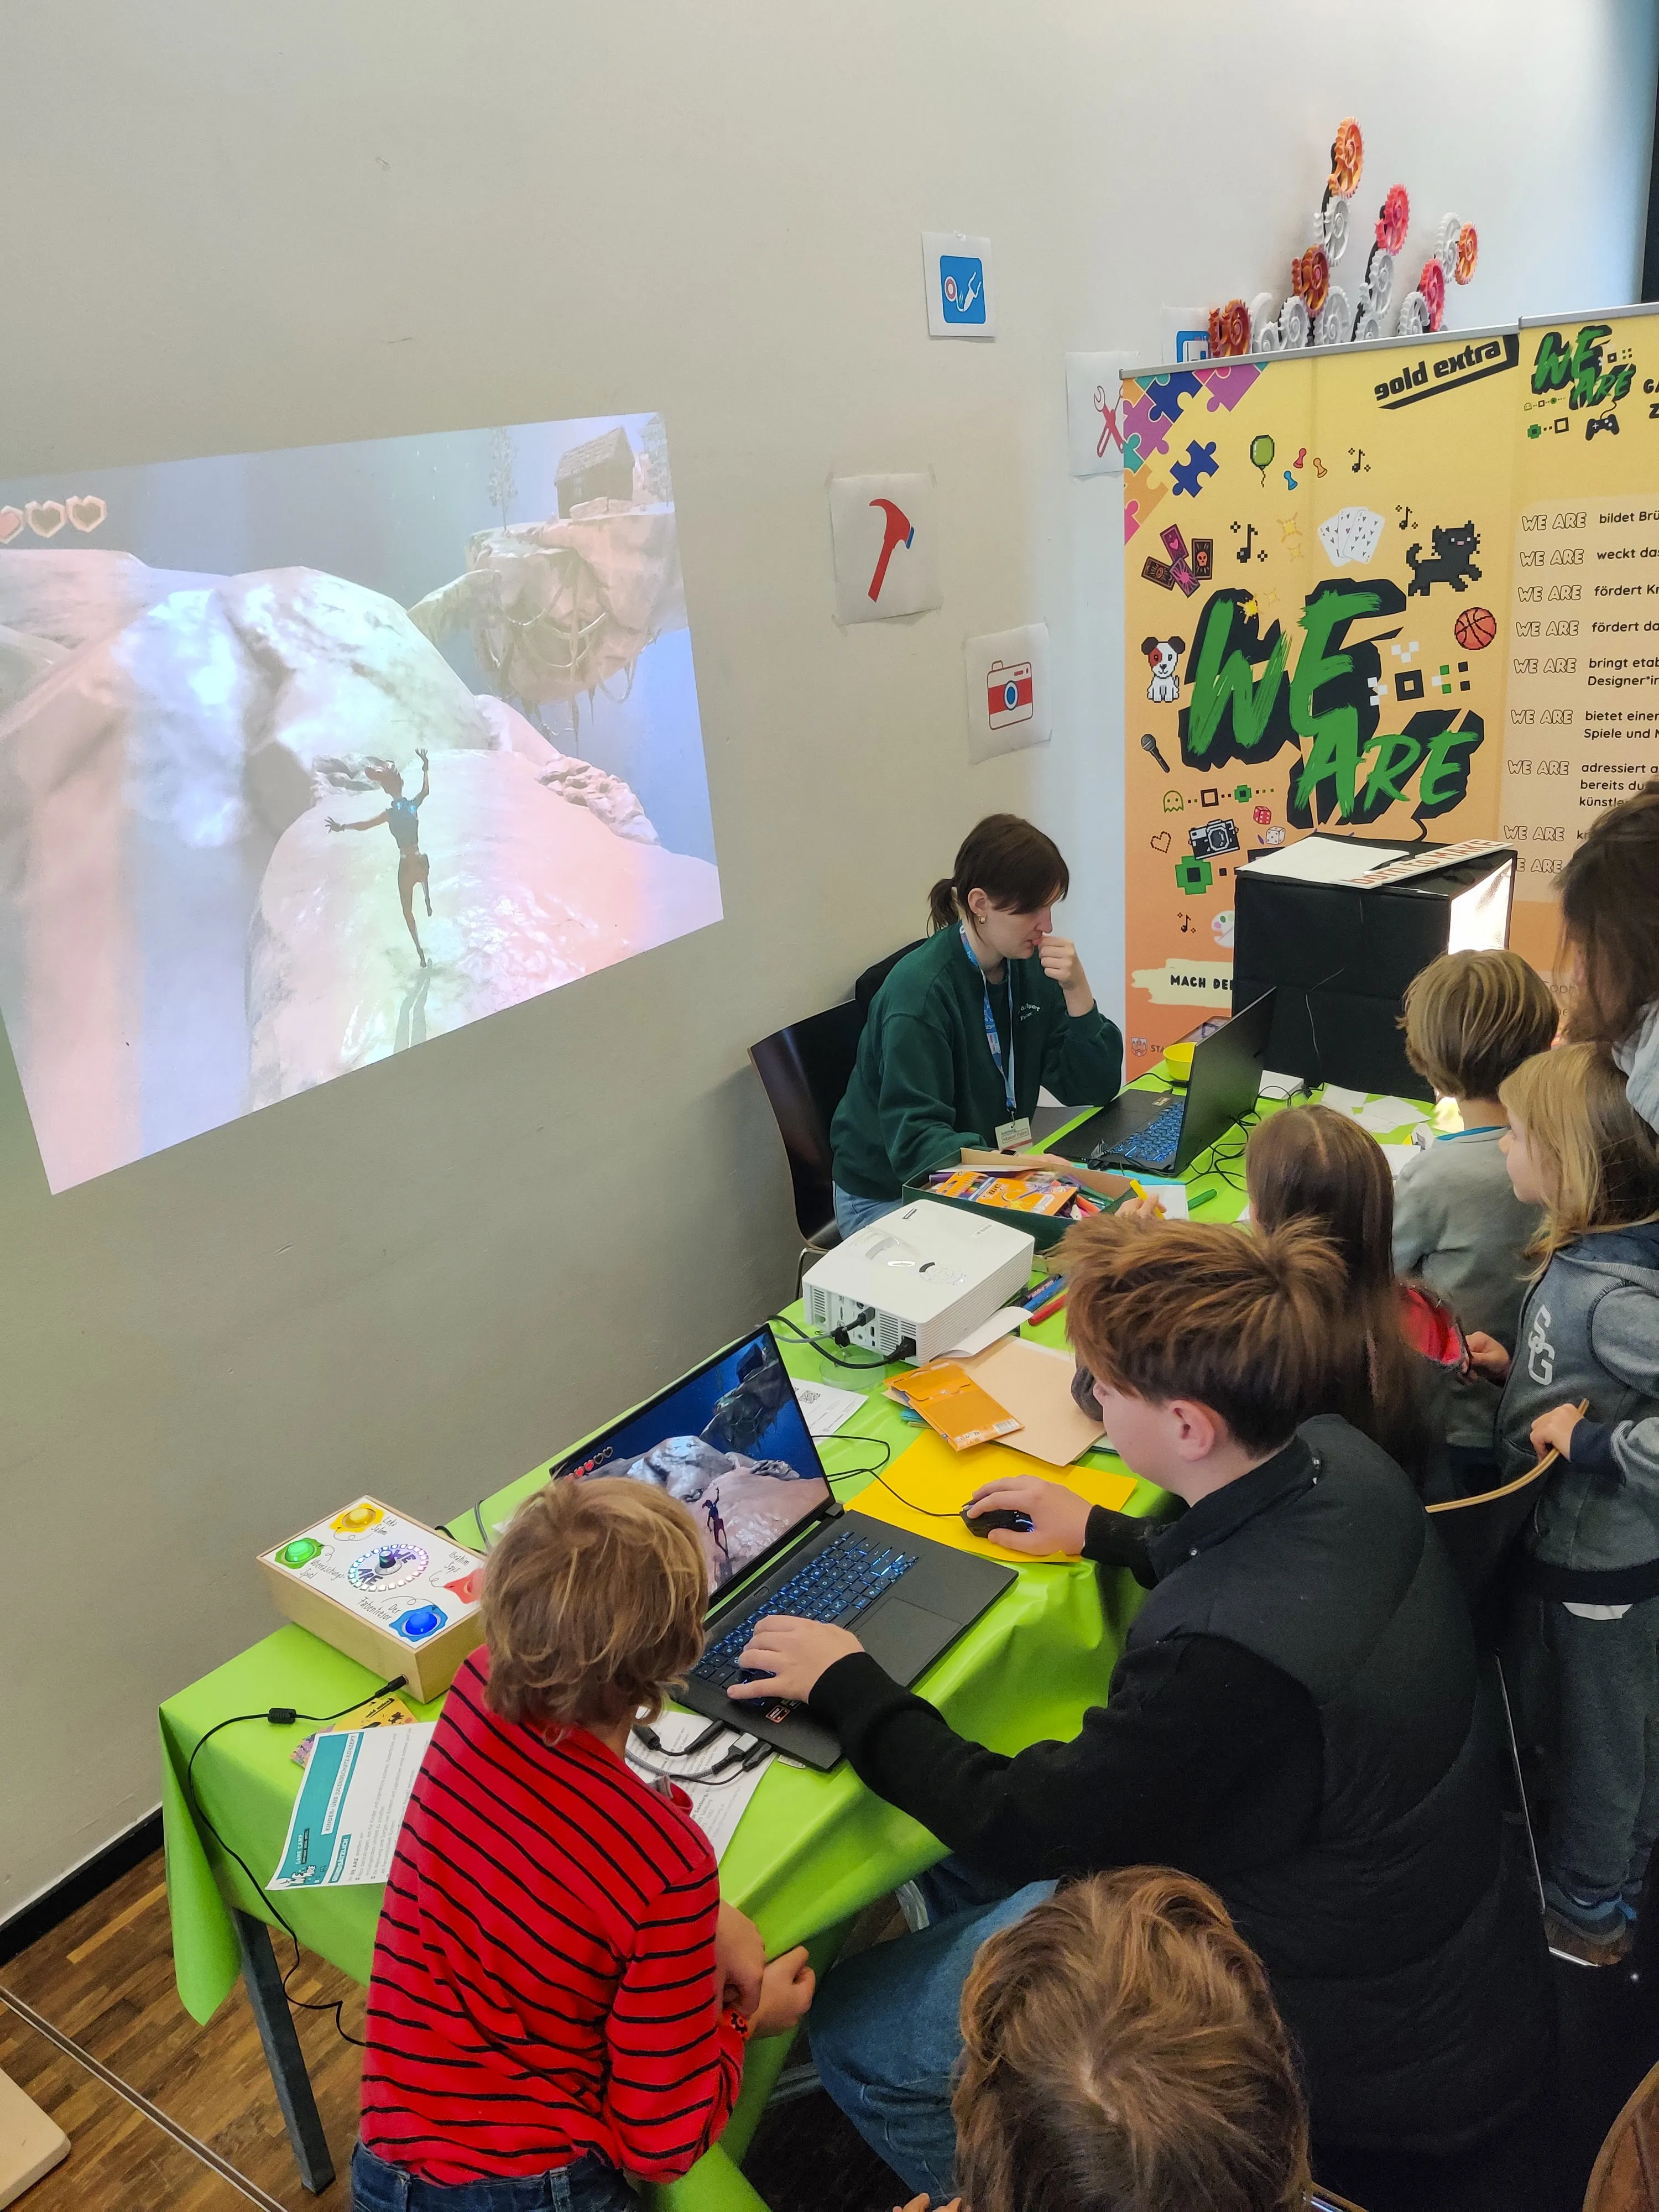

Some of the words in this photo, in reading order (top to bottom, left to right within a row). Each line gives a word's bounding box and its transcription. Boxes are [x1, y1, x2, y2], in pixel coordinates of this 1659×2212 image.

[1531, 326, 1610, 394] WE
[1374, 361, 1428, 401] gold
[1433, 341, 1501, 378] extra
[1570, 364, 1636, 408] ARE
[1522, 514, 1547, 531] WE
[1552, 512, 1587, 529] ARE
[1599, 512, 1635, 524] bildet
[1639, 510, 1659, 521] Brü
[1520, 551, 1545, 567] WE
[1550, 549, 1584, 565] ARE
[1597, 548, 1636, 560] weckt
[1517, 586, 1543, 602] WE
[1548, 585, 1582, 601] ARE
[1594, 585, 1642, 597] fördert
[1516, 622, 1541, 637] WE
[1546, 620, 1579, 636] ARE
[1592, 622, 1639, 633] fördert
[1181, 580, 1396, 766] WE
[1514, 659, 1538, 674] WE
[1543, 658, 1577, 673] ARE
[1589, 658, 1629, 670] bringt
[1511, 709, 1535, 724] WE
[1540, 709, 1573, 724] ARE
[1585, 711, 1623, 721] bietet
[1583, 728, 1622, 740] Spiele
[1626, 728, 1650, 738] und
[1290, 703, 1483, 824] ARE
[1507, 760, 1532, 774] WE
[1537, 760, 1569, 775] ARE
[1582, 763, 1646, 773] adressiert
[1580, 779, 1624, 790] bereits
[1504, 826, 1527, 840] WE
[1532, 827, 1564, 841] ARE
[1428, 840, 1503, 860] MAKE
[1516, 858, 1526, 872] E
[1531, 859, 1563, 873] ARE
[1170, 974, 1206, 988] MACH
[358, 1568, 383, 1585] ARE
